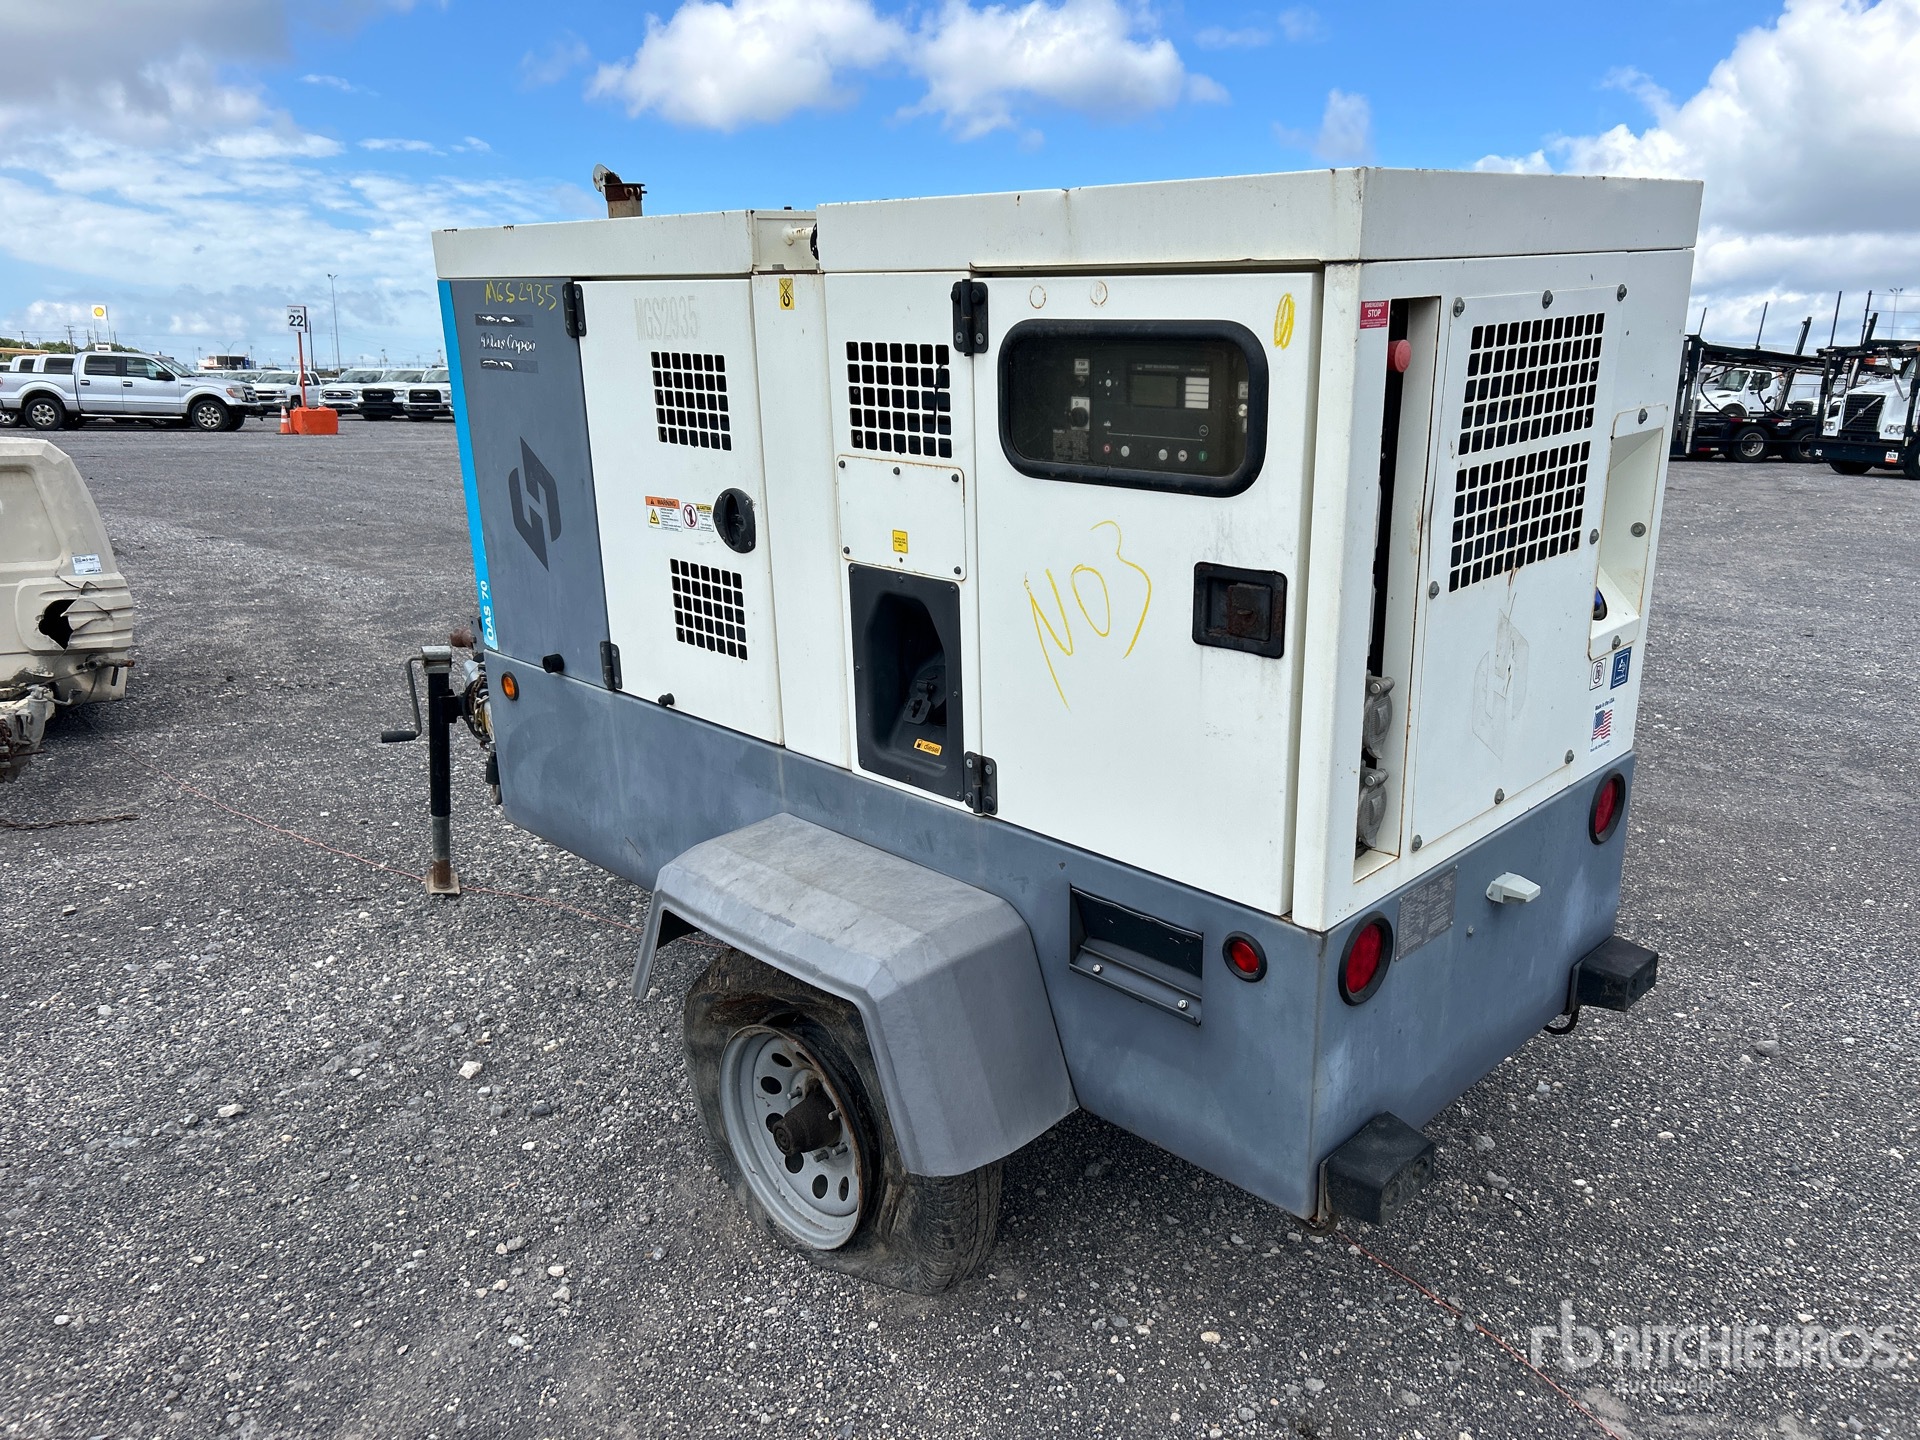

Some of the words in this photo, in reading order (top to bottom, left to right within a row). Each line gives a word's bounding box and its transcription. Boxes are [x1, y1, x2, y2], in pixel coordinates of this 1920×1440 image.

[485, 280, 557, 311] MGS2935
[289, 314, 304, 326] 22
[1368, 309, 1381, 318] STOP
[480, 580, 490, 600] 70
